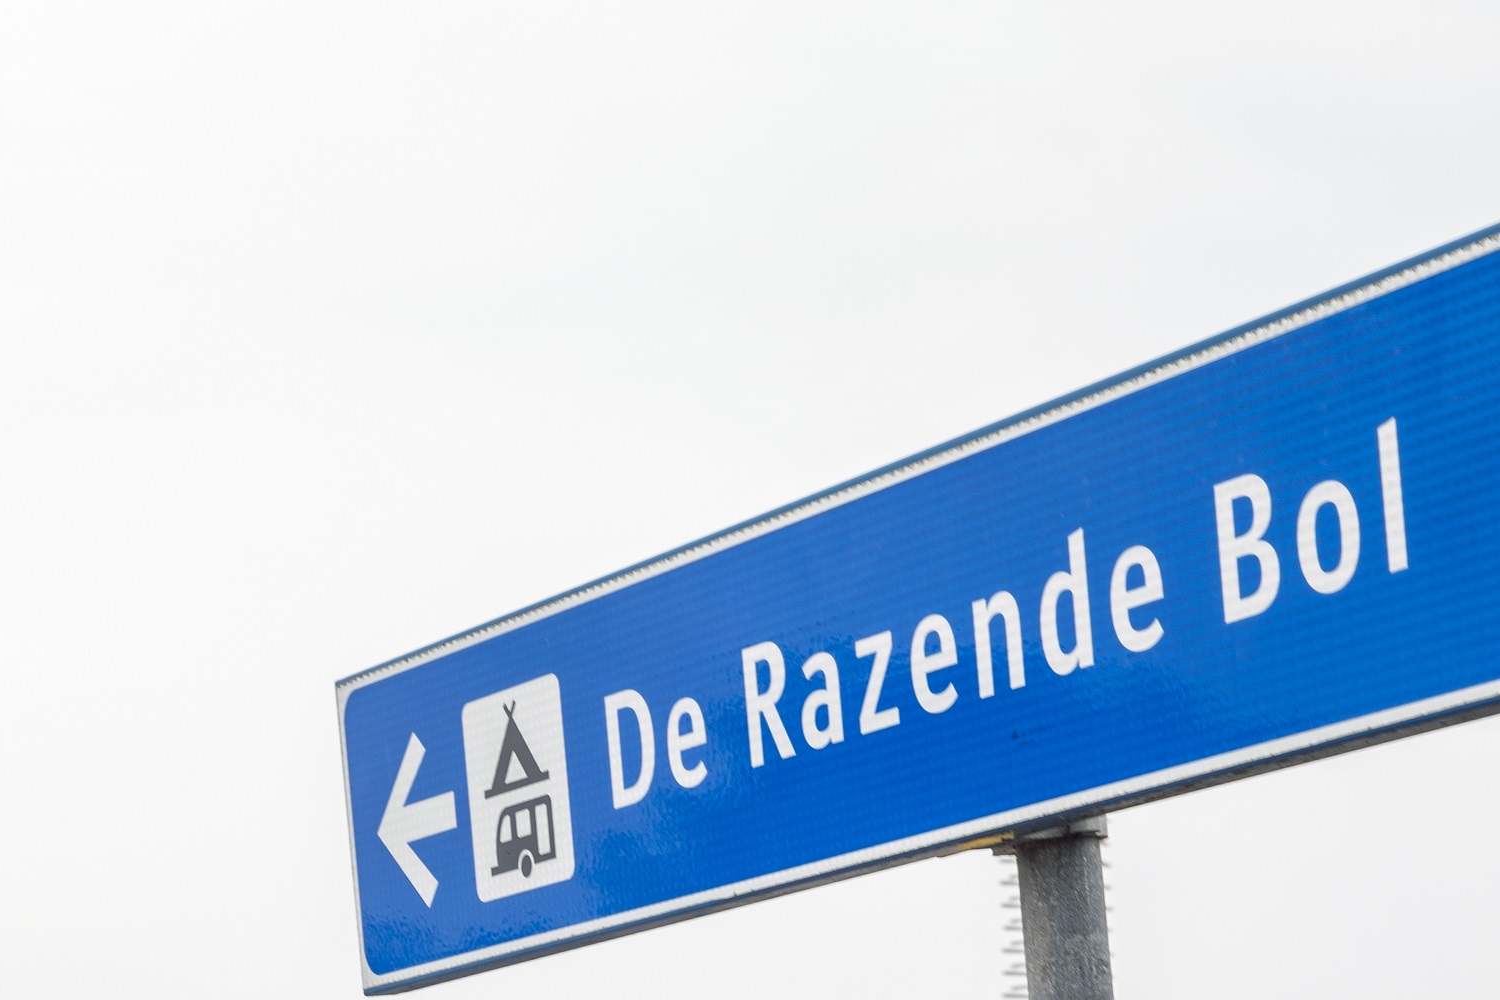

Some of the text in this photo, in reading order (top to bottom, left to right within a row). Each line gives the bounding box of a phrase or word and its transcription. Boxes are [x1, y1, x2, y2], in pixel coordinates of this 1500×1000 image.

[603, 416, 1409, 810] De Razende Bol
